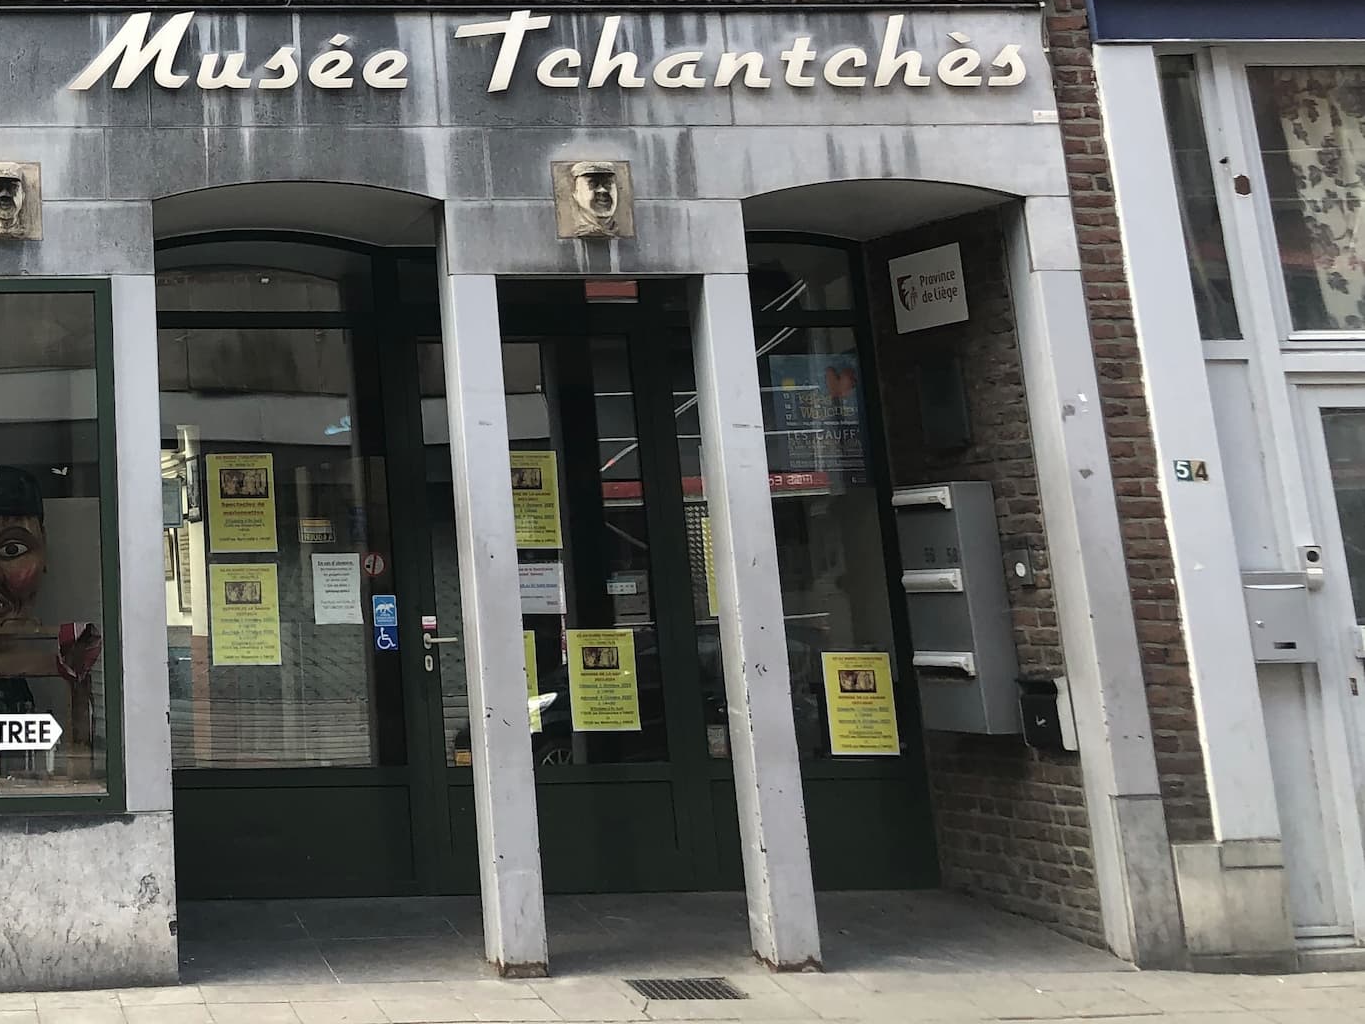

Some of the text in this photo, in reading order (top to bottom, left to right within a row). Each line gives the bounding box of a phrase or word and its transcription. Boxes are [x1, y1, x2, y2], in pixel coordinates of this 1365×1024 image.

[67, 11, 409, 91] Musée
[454, 9, 1028, 93] Tchantchès
[919, 270, 956, 287] Province
[921, 286, 958, 303] de Liège
[1176, 460, 1209, 481] 54
